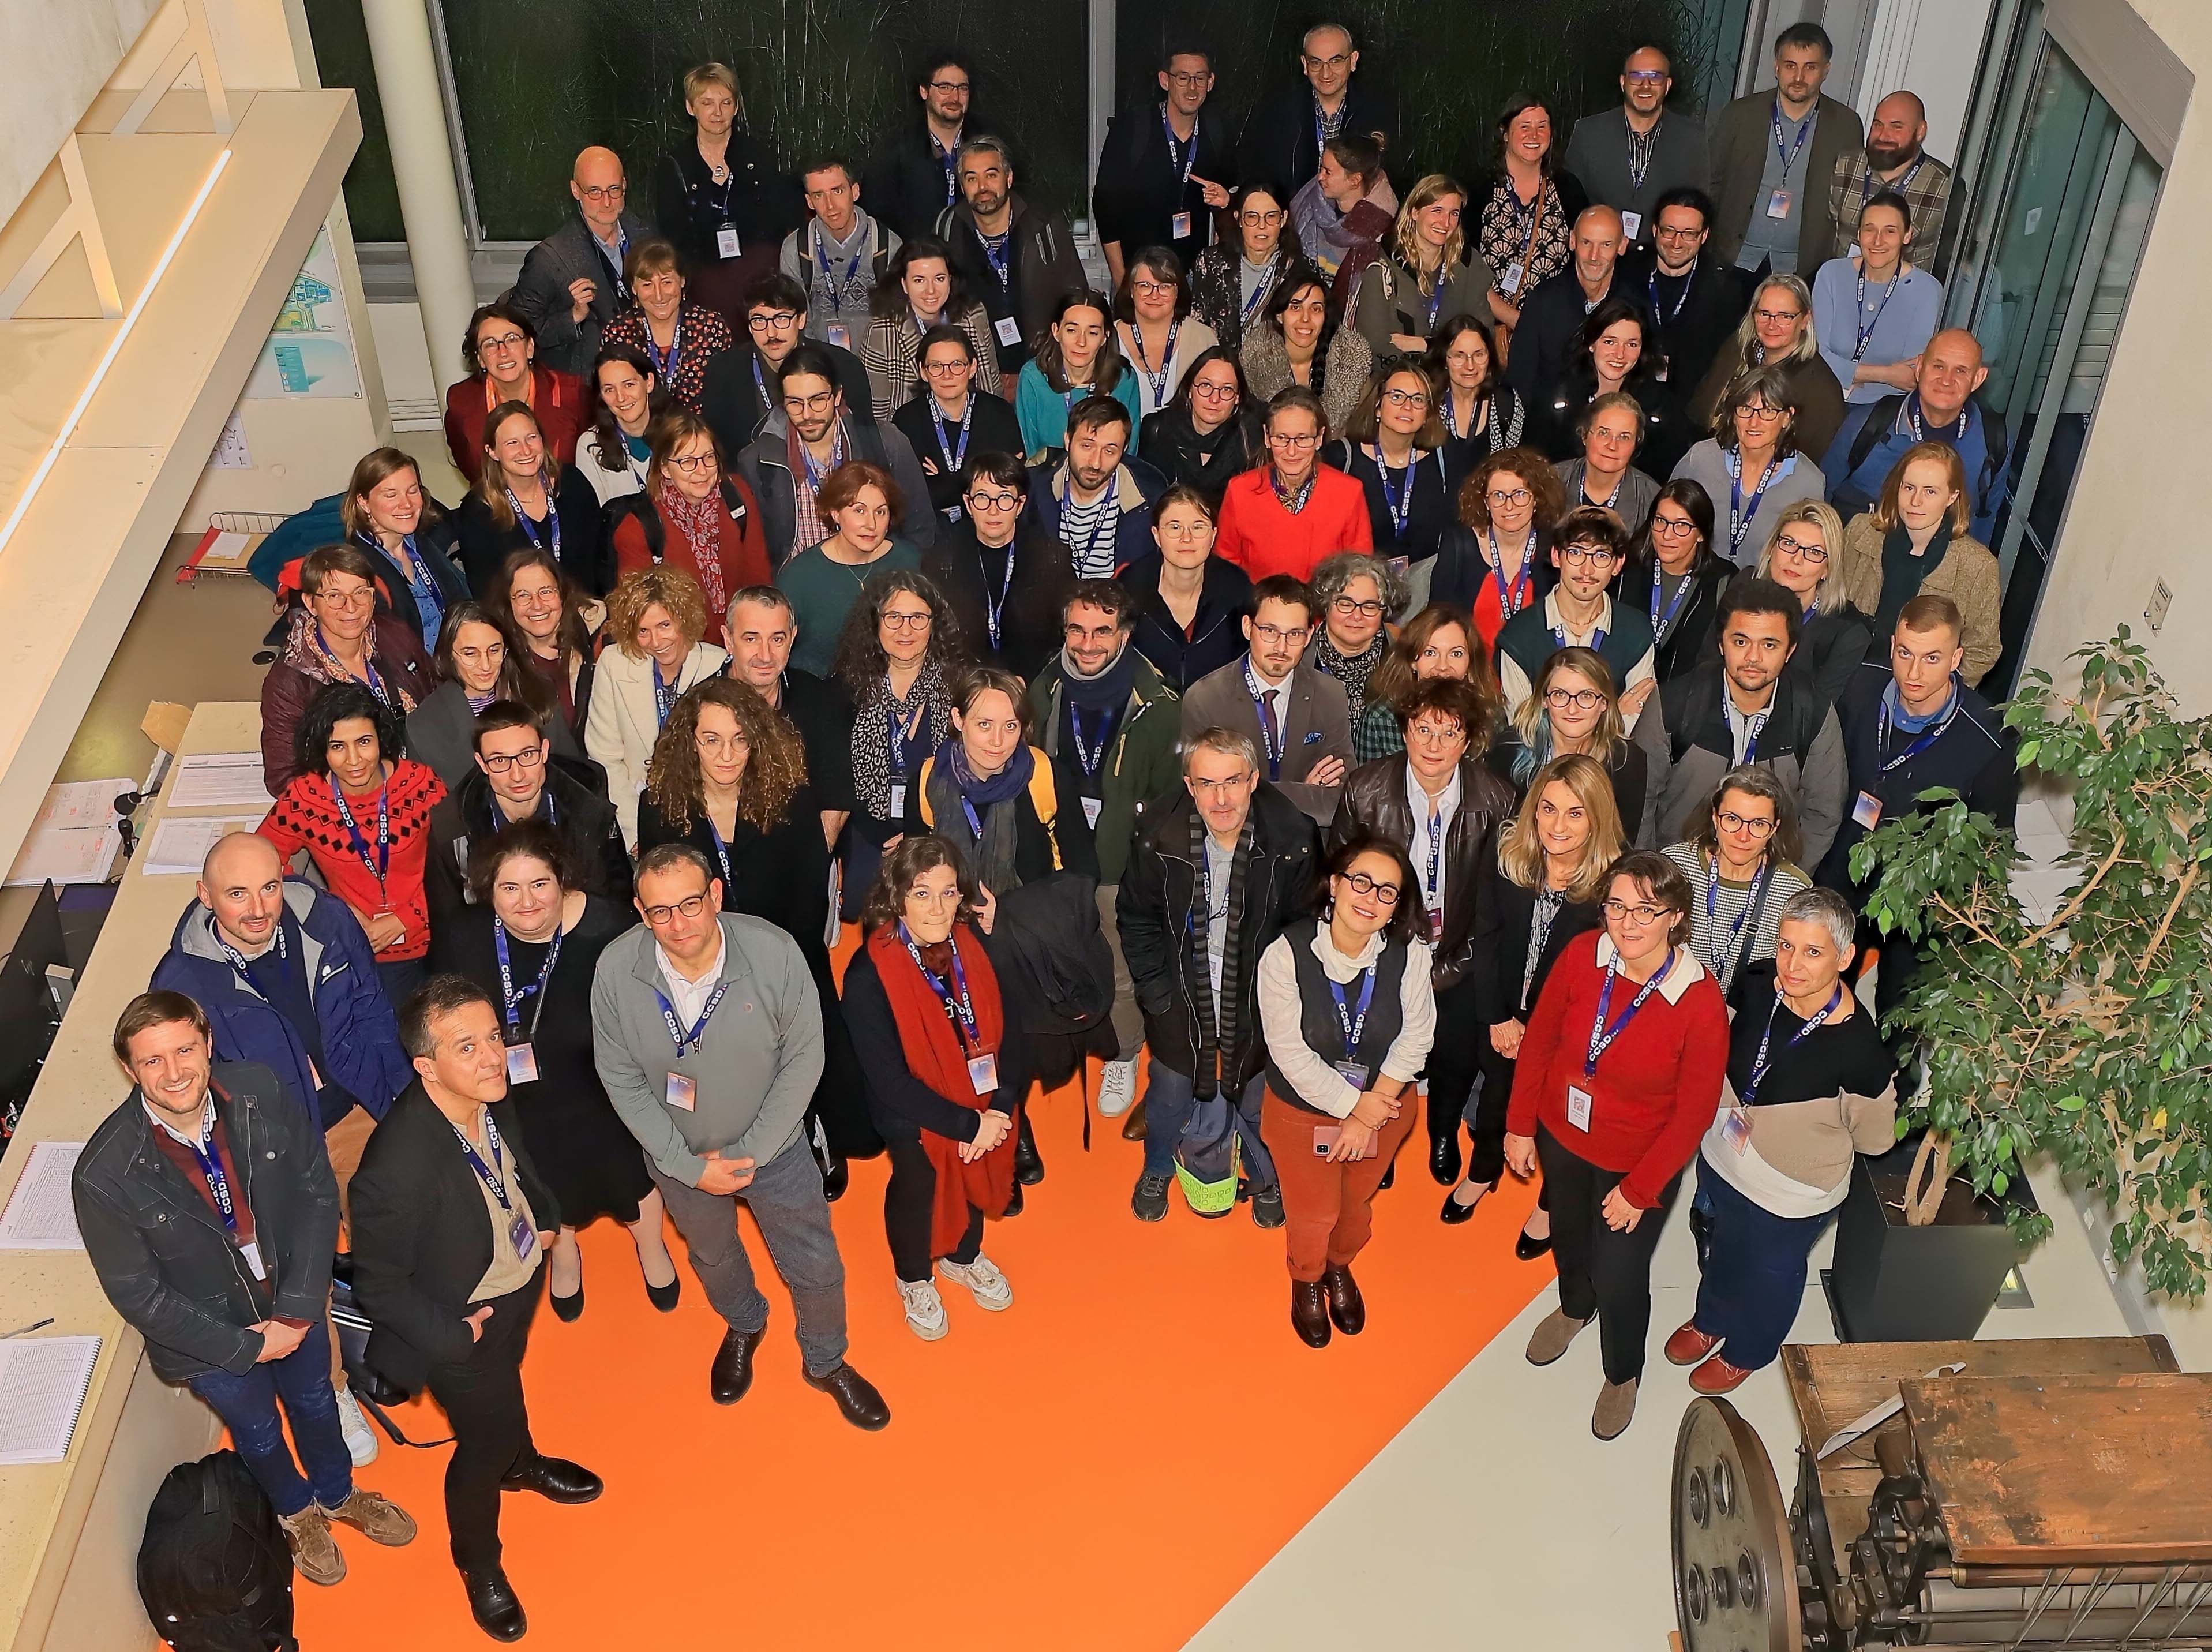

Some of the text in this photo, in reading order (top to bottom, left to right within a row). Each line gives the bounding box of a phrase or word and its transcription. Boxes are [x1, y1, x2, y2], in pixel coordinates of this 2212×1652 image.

[1775, 123, 1783, 146] CCSD
[1169, 140, 1178, 163] CCSD
[1904, 164, 1919, 186] CCSD
[1525, 217, 1534, 240] CCSD
[1258, 267, 1273, 289] CCSD
[1159, 363, 1169, 385] CCSD
[929, 398, 940, 422] CCSD
[1913, 414, 1924, 441] CCSD
[1957, 413, 1966, 439] CCSD
[943, 448, 955, 472] CCSD
[1377, 453, 1388, 480] CCSD
[1757, 467, 1772, 495] CCSD
[506, 489, 522, 514] CCSD
[1095, 502, 1109, 528] CCSD
[1402, 490, 1411, 516] CCSD
[1734, 520, 1748, 546] CCSD
[1490, 540, 1501, 568] CCSD
[1524, 537, 1536, 564] CCSD
[415, 561, 432, 585] CCSD
[1501, 594, 1510, 620] CCSD
[1244, 672, 1260, 702] CCSD
[656, 688, 665, 717] CCSD
[1075, 735, 1088, 762] CCSD
[1091, 746, 1103, 771] CCSD
[1883, 755, 1906, 771] CCSD
[338, 799, 354, 828] CCSD
[279, 926, 287, 959] CCSD
[223, 944, 246, 970] CCSD
[503, 964, 513, 998] CCSD
[1633, 980, 1655, 1007] CCSD
[702, 989, 723, 1020] CCSD
[962, 991, 975, 1024] CCSD
[1339, 1002, 1352, 1033] CCSD
[663, 1010, 680, 1044] CCSD
[1351, 1013, 1365, 1044] CCSD
[1591, 1014, 1604, 1048] CCSD
[1802, 1009, 1828, 1036] CCSD
[1589, 1036, 1612, 1062] CCSD
[1754, 1037, 1769, 1068] CCSD
[486, 1115, 501, 1148] CCSD
[218, 1181, 232, 1215] CCSD
[485, 1176, 505, 1198] CCSD
